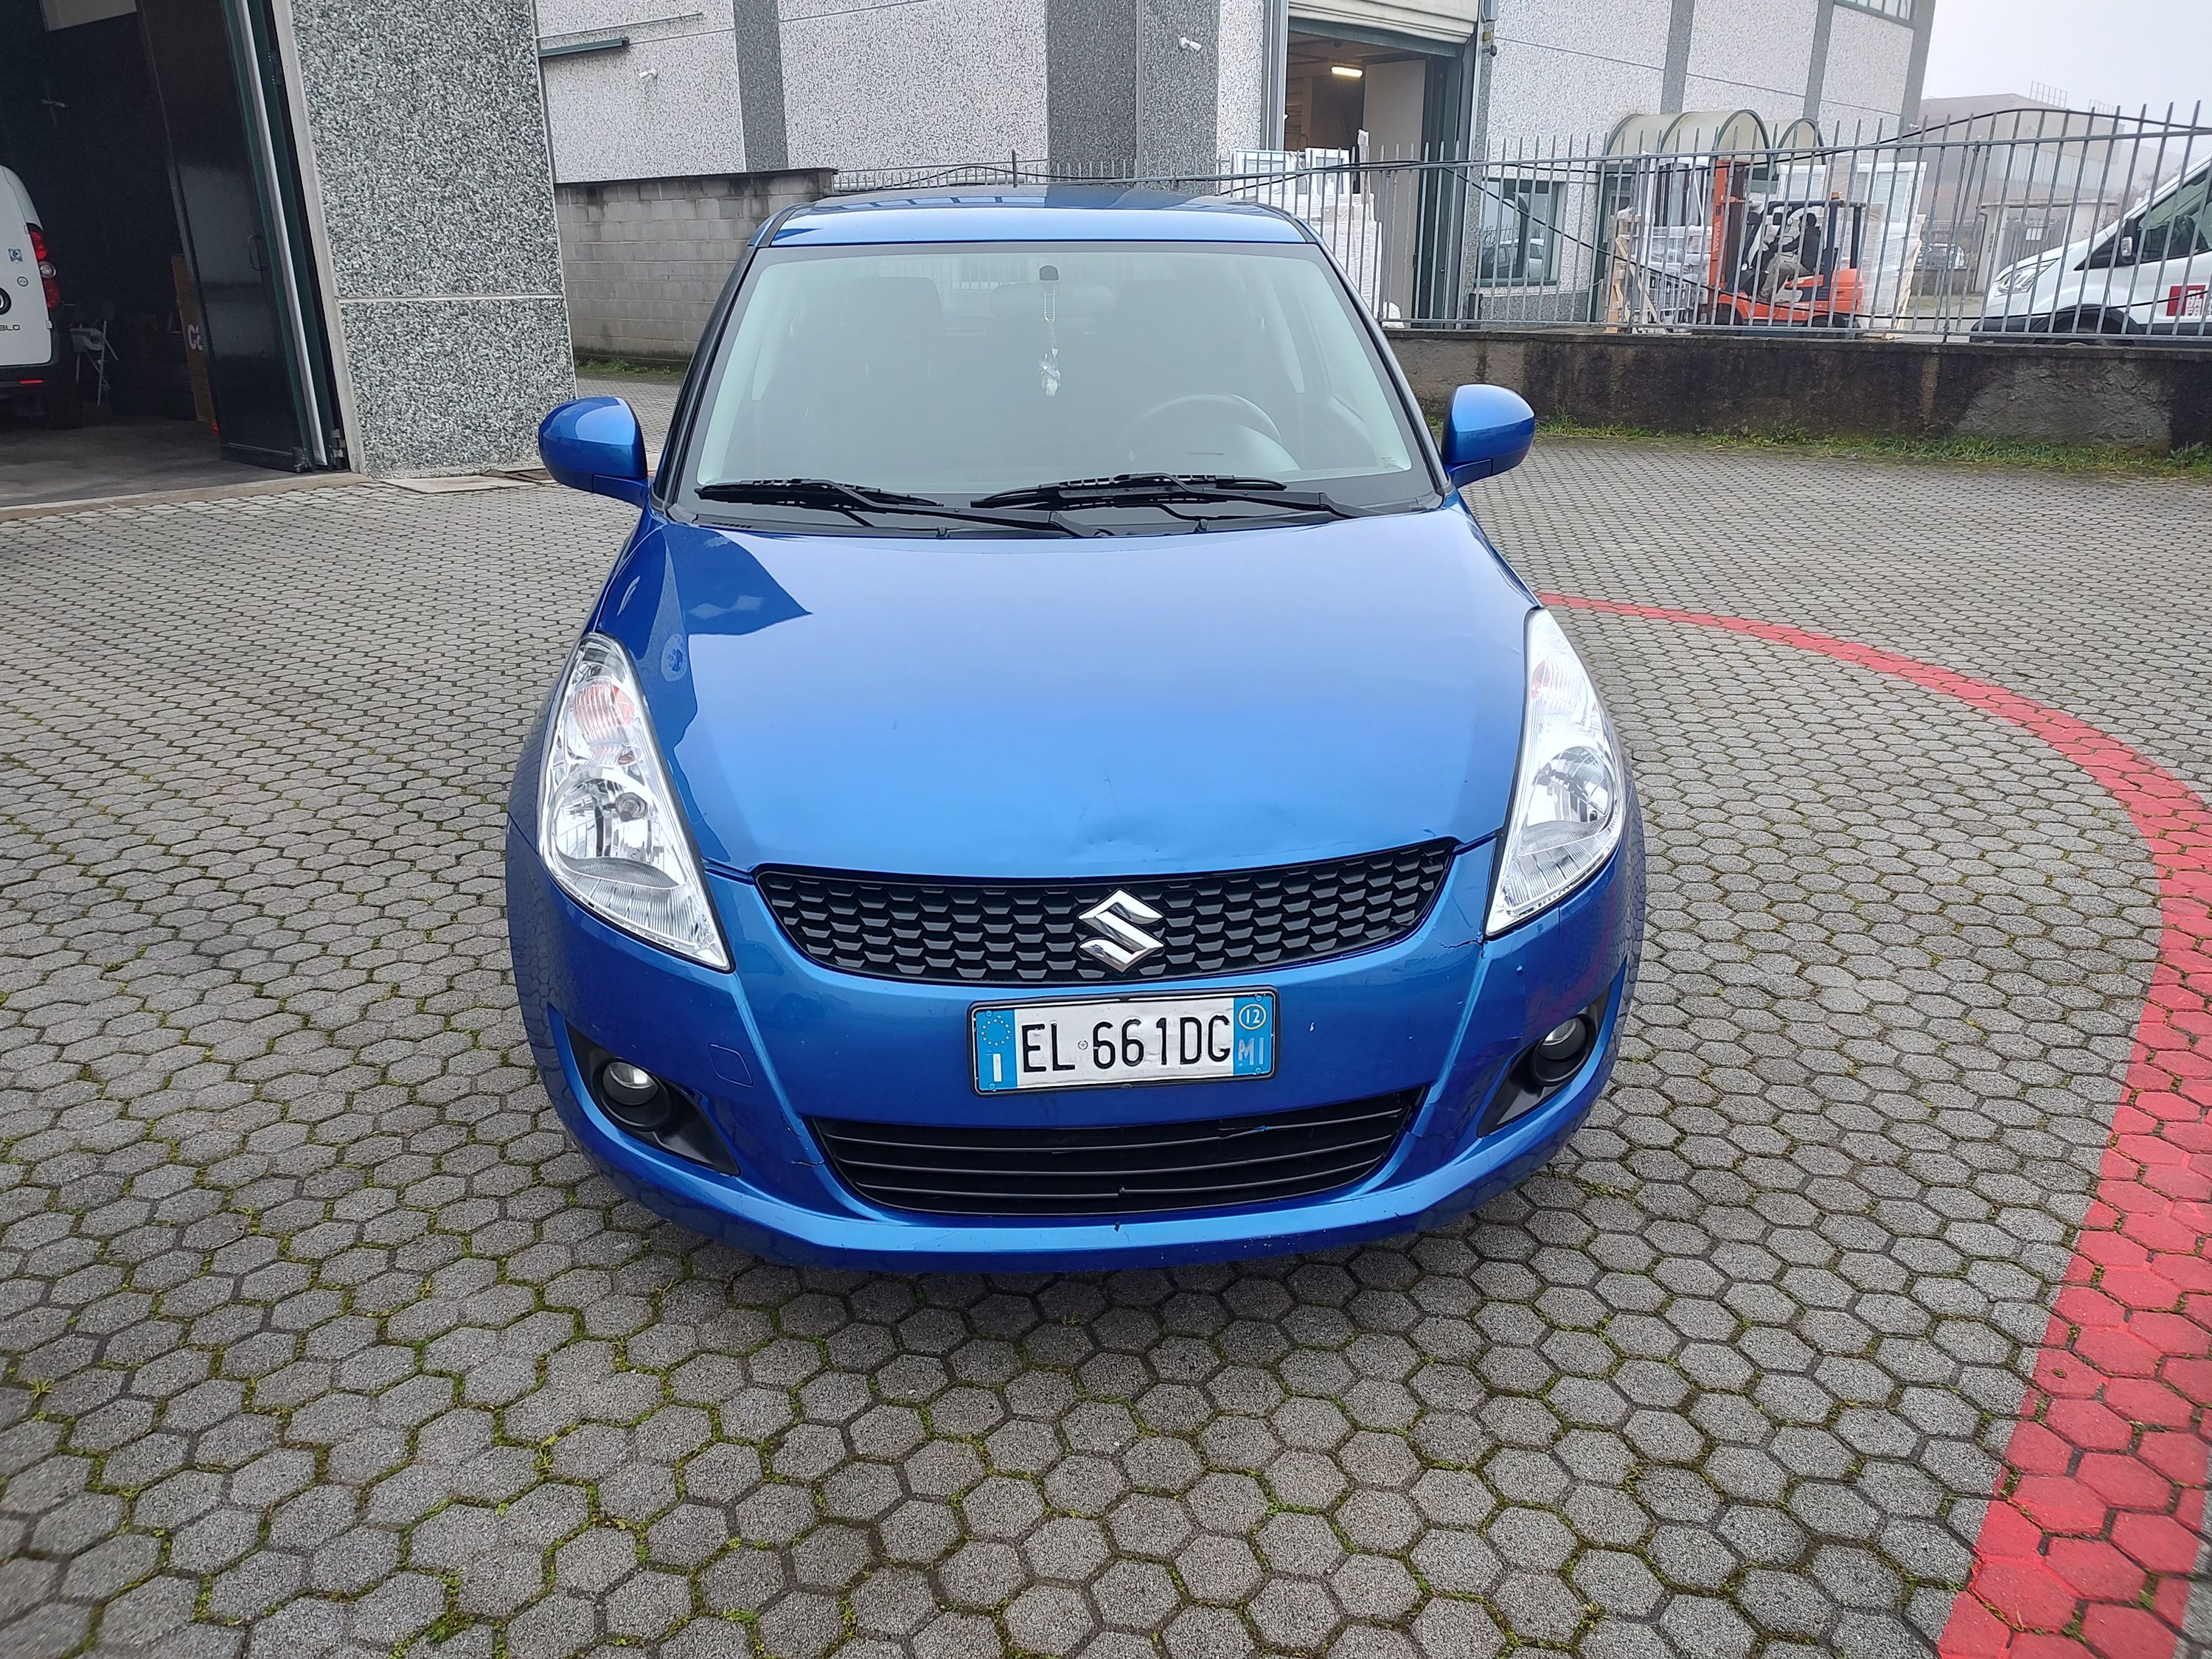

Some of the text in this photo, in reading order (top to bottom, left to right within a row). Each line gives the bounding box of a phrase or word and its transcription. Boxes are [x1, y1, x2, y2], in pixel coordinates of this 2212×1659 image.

[1246, 1009, 1261, 1024] 12
[992, 1053, 1003, 1082] I
[1021, 1022, 1076, 1073] EL
[1238, 1037, 1265, 1067] MI
